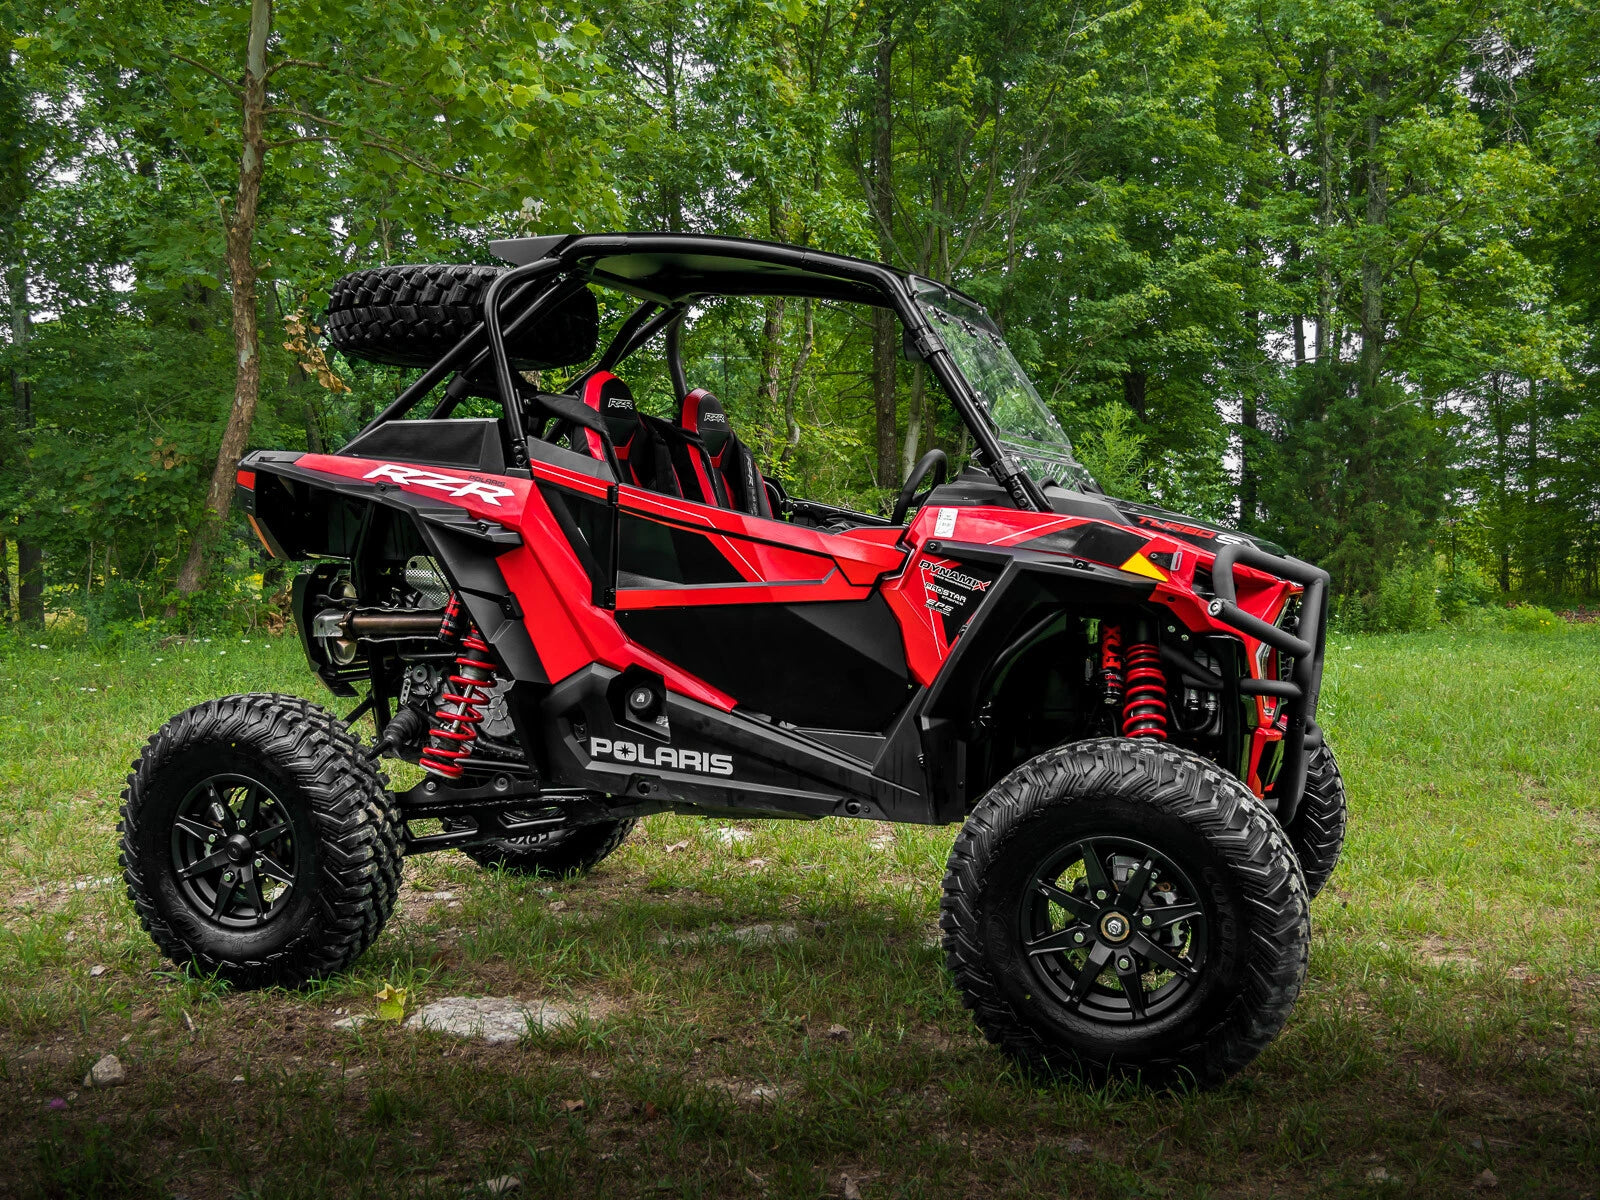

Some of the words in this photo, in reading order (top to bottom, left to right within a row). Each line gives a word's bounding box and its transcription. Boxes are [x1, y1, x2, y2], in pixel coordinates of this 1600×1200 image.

[608, 398, 634, 410] RZR
[362, 463, 515, 506] RZR
[468, 475, 506, 488] POLARIS
[1137, 515, 1217, 539] TURBO
[919, 559, 992, 592] DYNAMIX
[925, 581, 967, 603] PROSTAR
[1101, 624, 1122, 670] FOX
[590, 736, 733, 775] POLARIS
